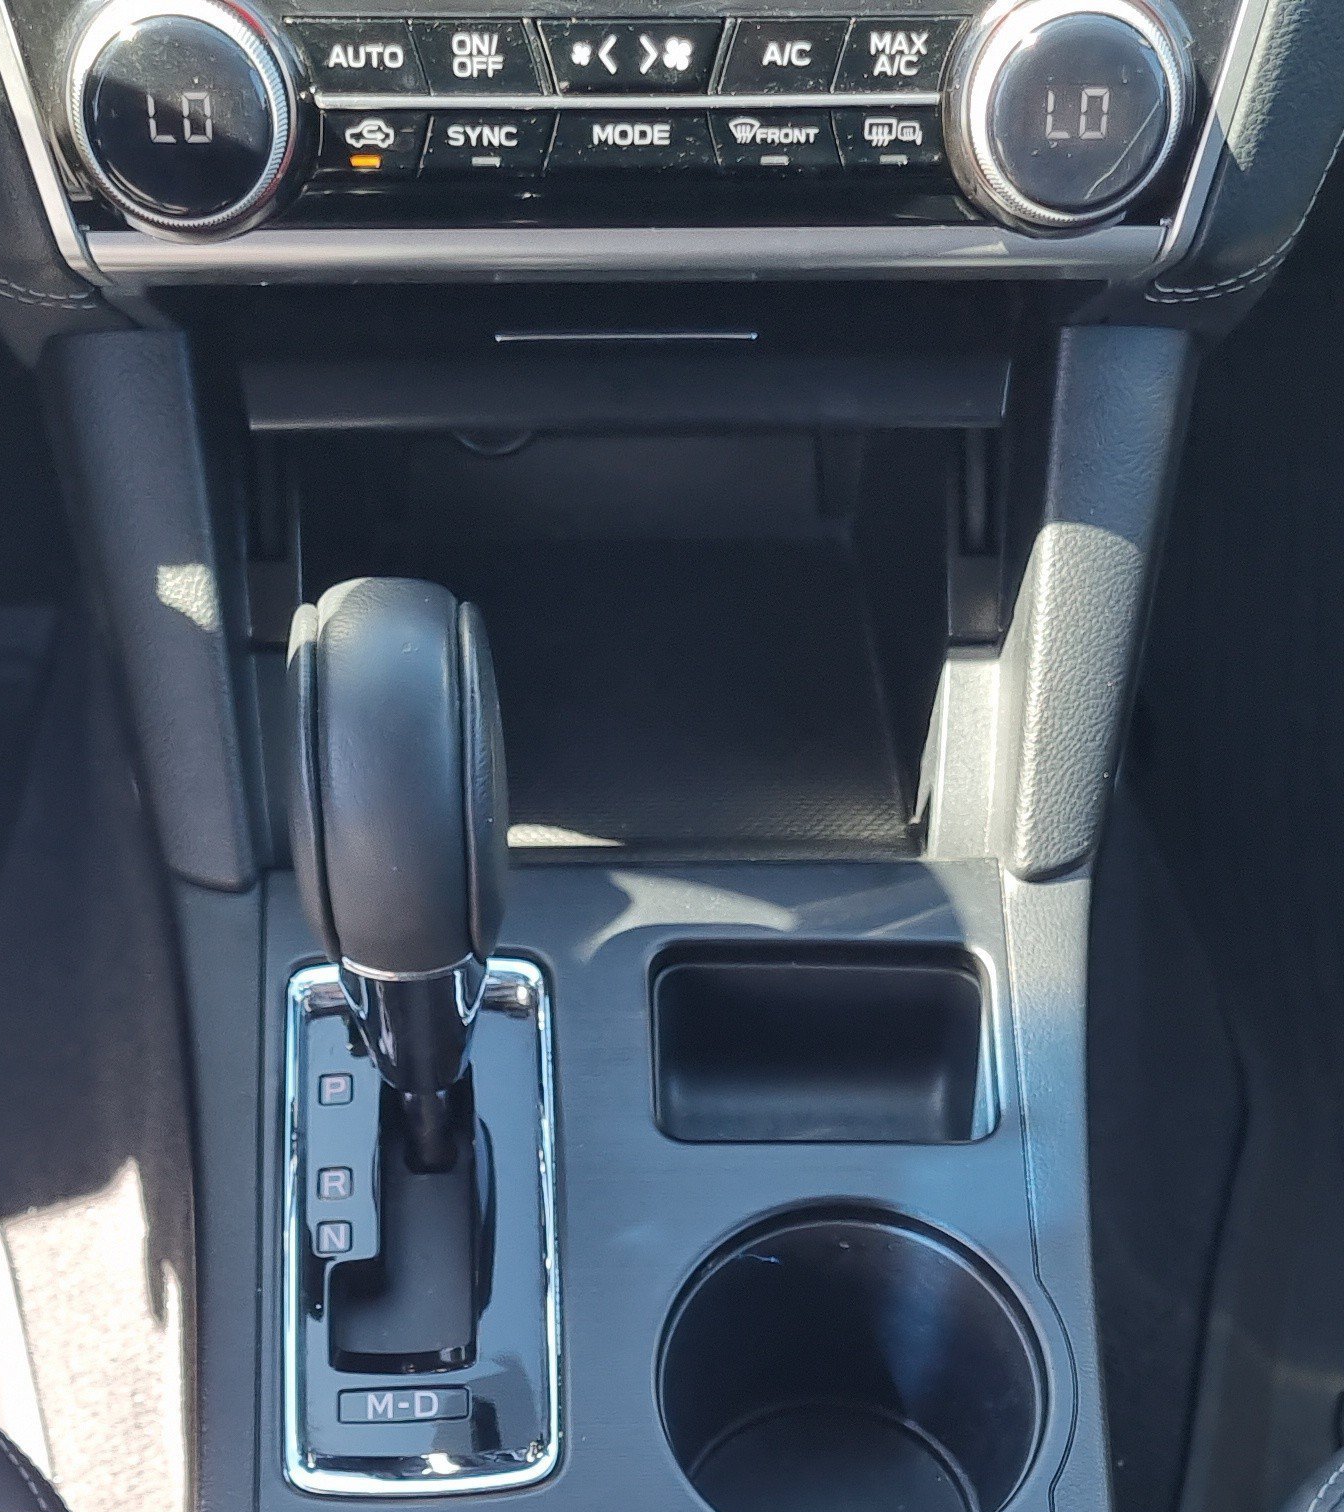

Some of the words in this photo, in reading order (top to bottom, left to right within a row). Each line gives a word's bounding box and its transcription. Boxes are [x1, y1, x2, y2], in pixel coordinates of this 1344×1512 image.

[451, 34, 498, 56] ON/
[763, 42, 812, 67] A/C
[870, 33, 927, 55] MAX
[328, 43, 405, 69] AUTO
[452, 56, 504, 78] OFF
[874, 54, 920, 77] A/C
[146, 92, 213, 143] LO
[1047, 87, 1109, 140] LO
[447, 126, 519, 148] SYNC
[592, 124, 670, 146] MODE
[756, 127, 819, 145] FRONT
[325, 1077, 347, 1100] P
[323, 1171, 347, 1196] R
[321, 1225, 347, 1250] N
[367, 1393, 439, 1419] M-D
